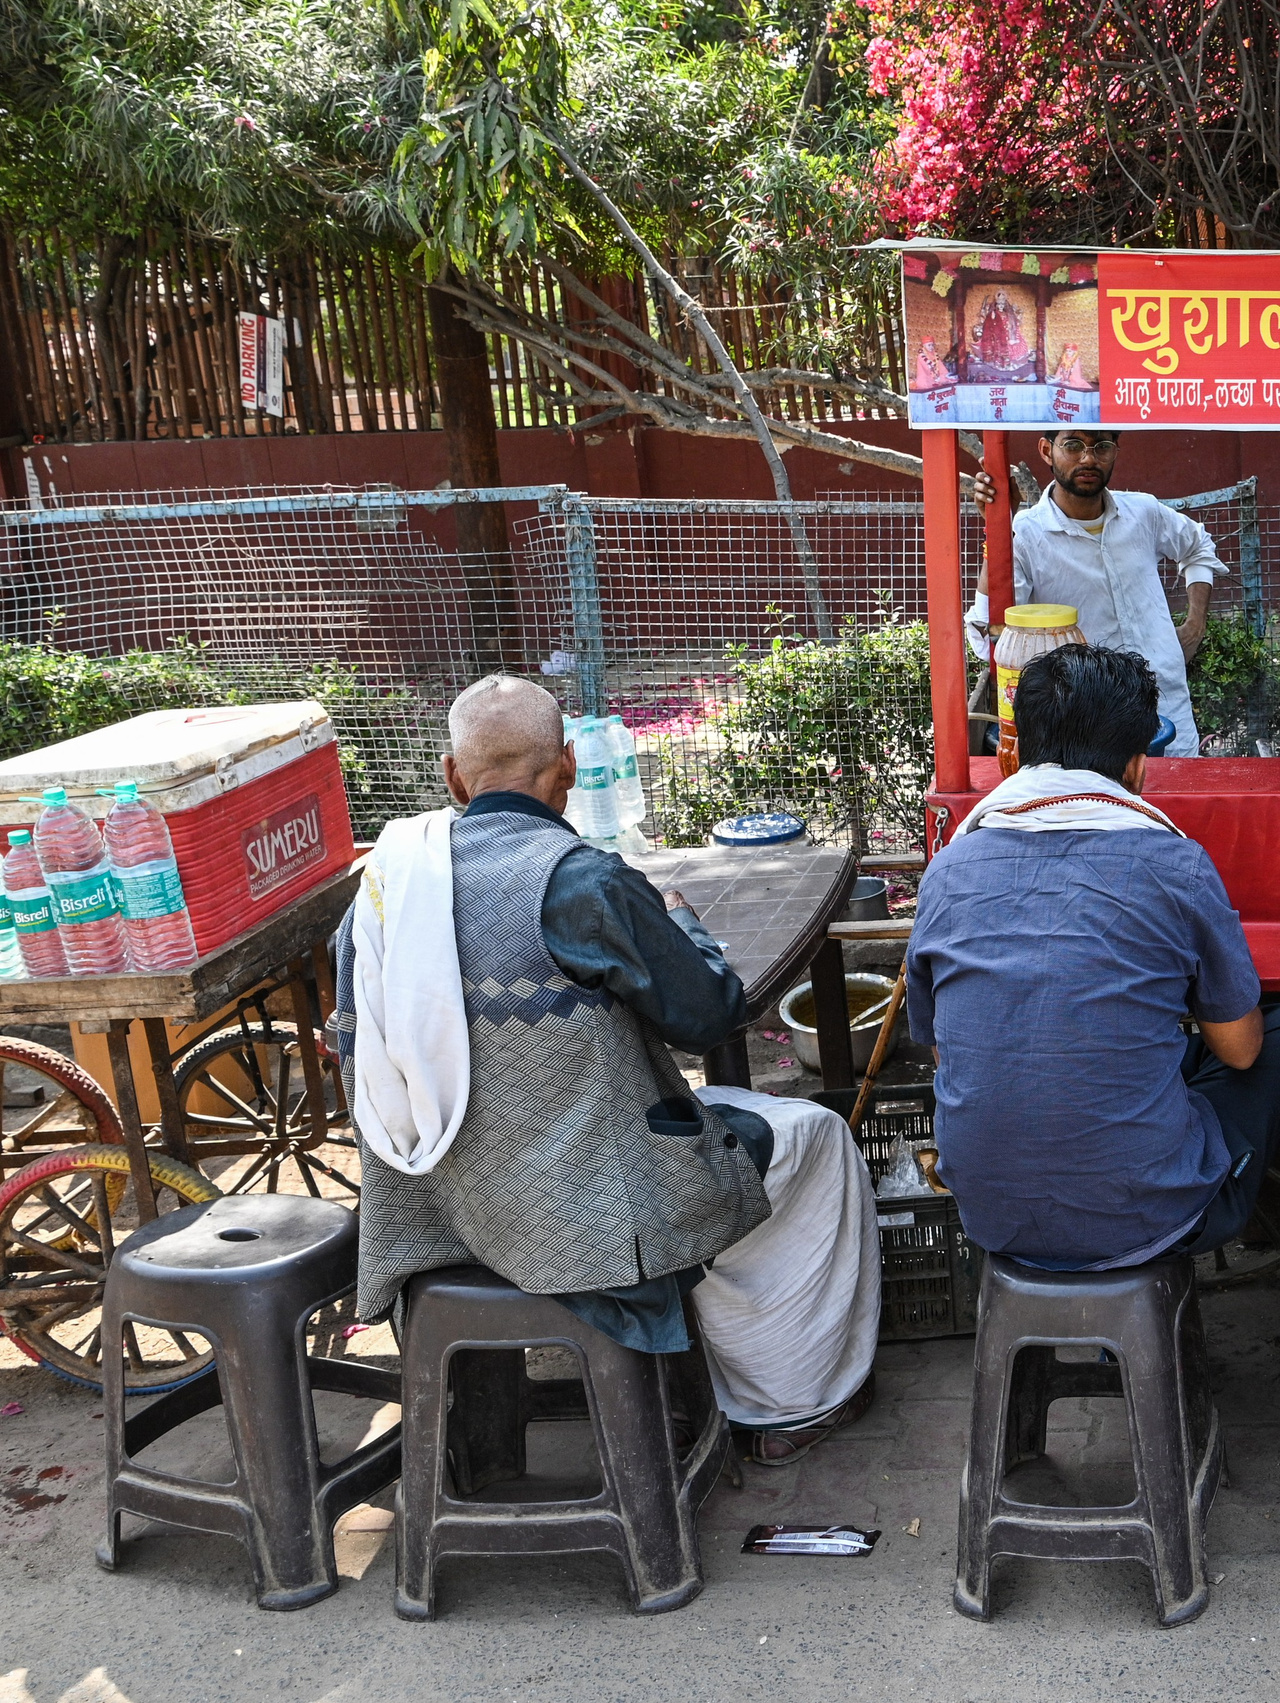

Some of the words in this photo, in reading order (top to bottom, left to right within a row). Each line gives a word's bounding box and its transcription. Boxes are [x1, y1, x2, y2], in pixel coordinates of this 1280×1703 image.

[241, 318, 256, 380] PARKING
[241, 383, 256, 403] NO
[989, 387, 1006, 397] जय
[1114, 377, 1152, 420] आलू
[1214, 378, 1257, 408] लच्छा
[246, 808, 320, 880] SUMERU
[249, 870, 281, 894] PACKAGED
[279, 854, 306, 877] DRINKING
[304, 844, 323, 864] WATER
[14, 906, 49, 924] Bisreli
[60, 887, 106, 913] Bisreli
